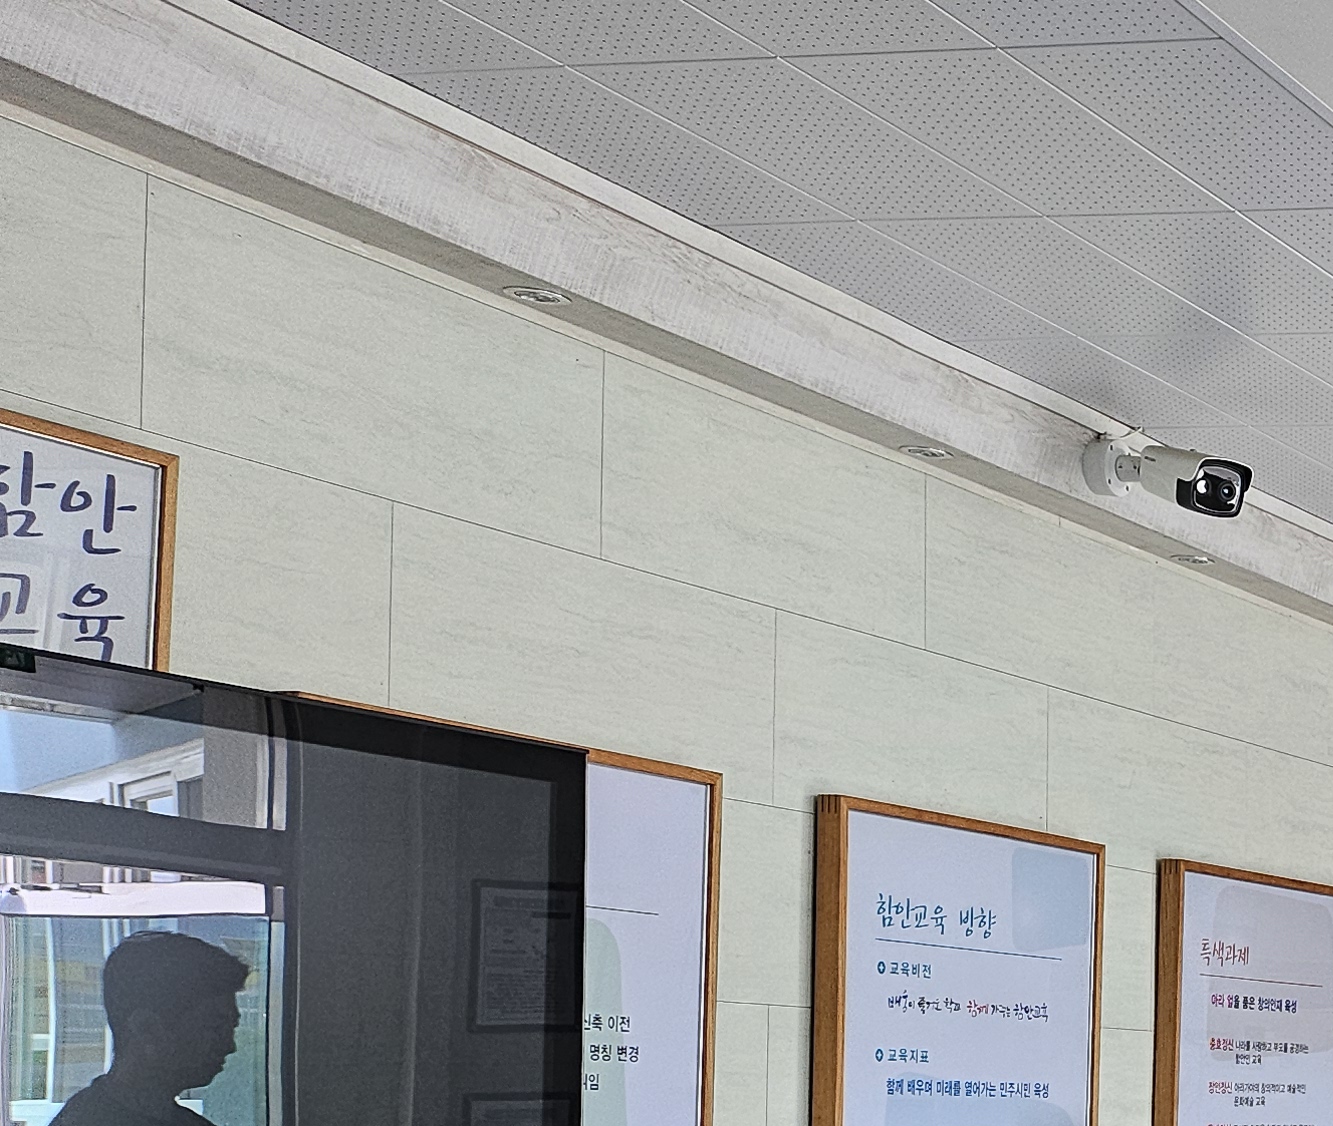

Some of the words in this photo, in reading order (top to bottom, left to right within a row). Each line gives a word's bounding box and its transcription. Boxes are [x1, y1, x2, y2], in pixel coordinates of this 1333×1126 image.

[876, 893, 947, 935] 함안교육
[959, 906, 996, 939] 방향
[1200, 938, 1249, 967] 특색과제
[889, 962, 932, 979] 교육비전
[967, 999, 989, 1017] 함께
[1013, 1002, 1048, 1023] 함안교육
[1211, 993, 1225, 1007] 아라
[1242, 996, 1255, 1010] 품은
[1258, 996, 1282, 1012] 창의인재
[1284, 999, 1297, 1013] 육성
[608, 1015, 630, 1032] 이전
[589, 1044, 611, 1061] 명칭
[617, 1046, 639, 1063] 변경
[887, 1049, 929, 1063] 교육지표
[886, 1078, 903, 1096] 함께
[907, 1079, 932, 1096] 배우며
[936, 1080, 961, 1097] 미래를
[965, 1081, 996, 1098] 열어가는
[1000, 1082, 1031, 1098] 민주시민
[1034, 1083, 1049, 1099] 육성
